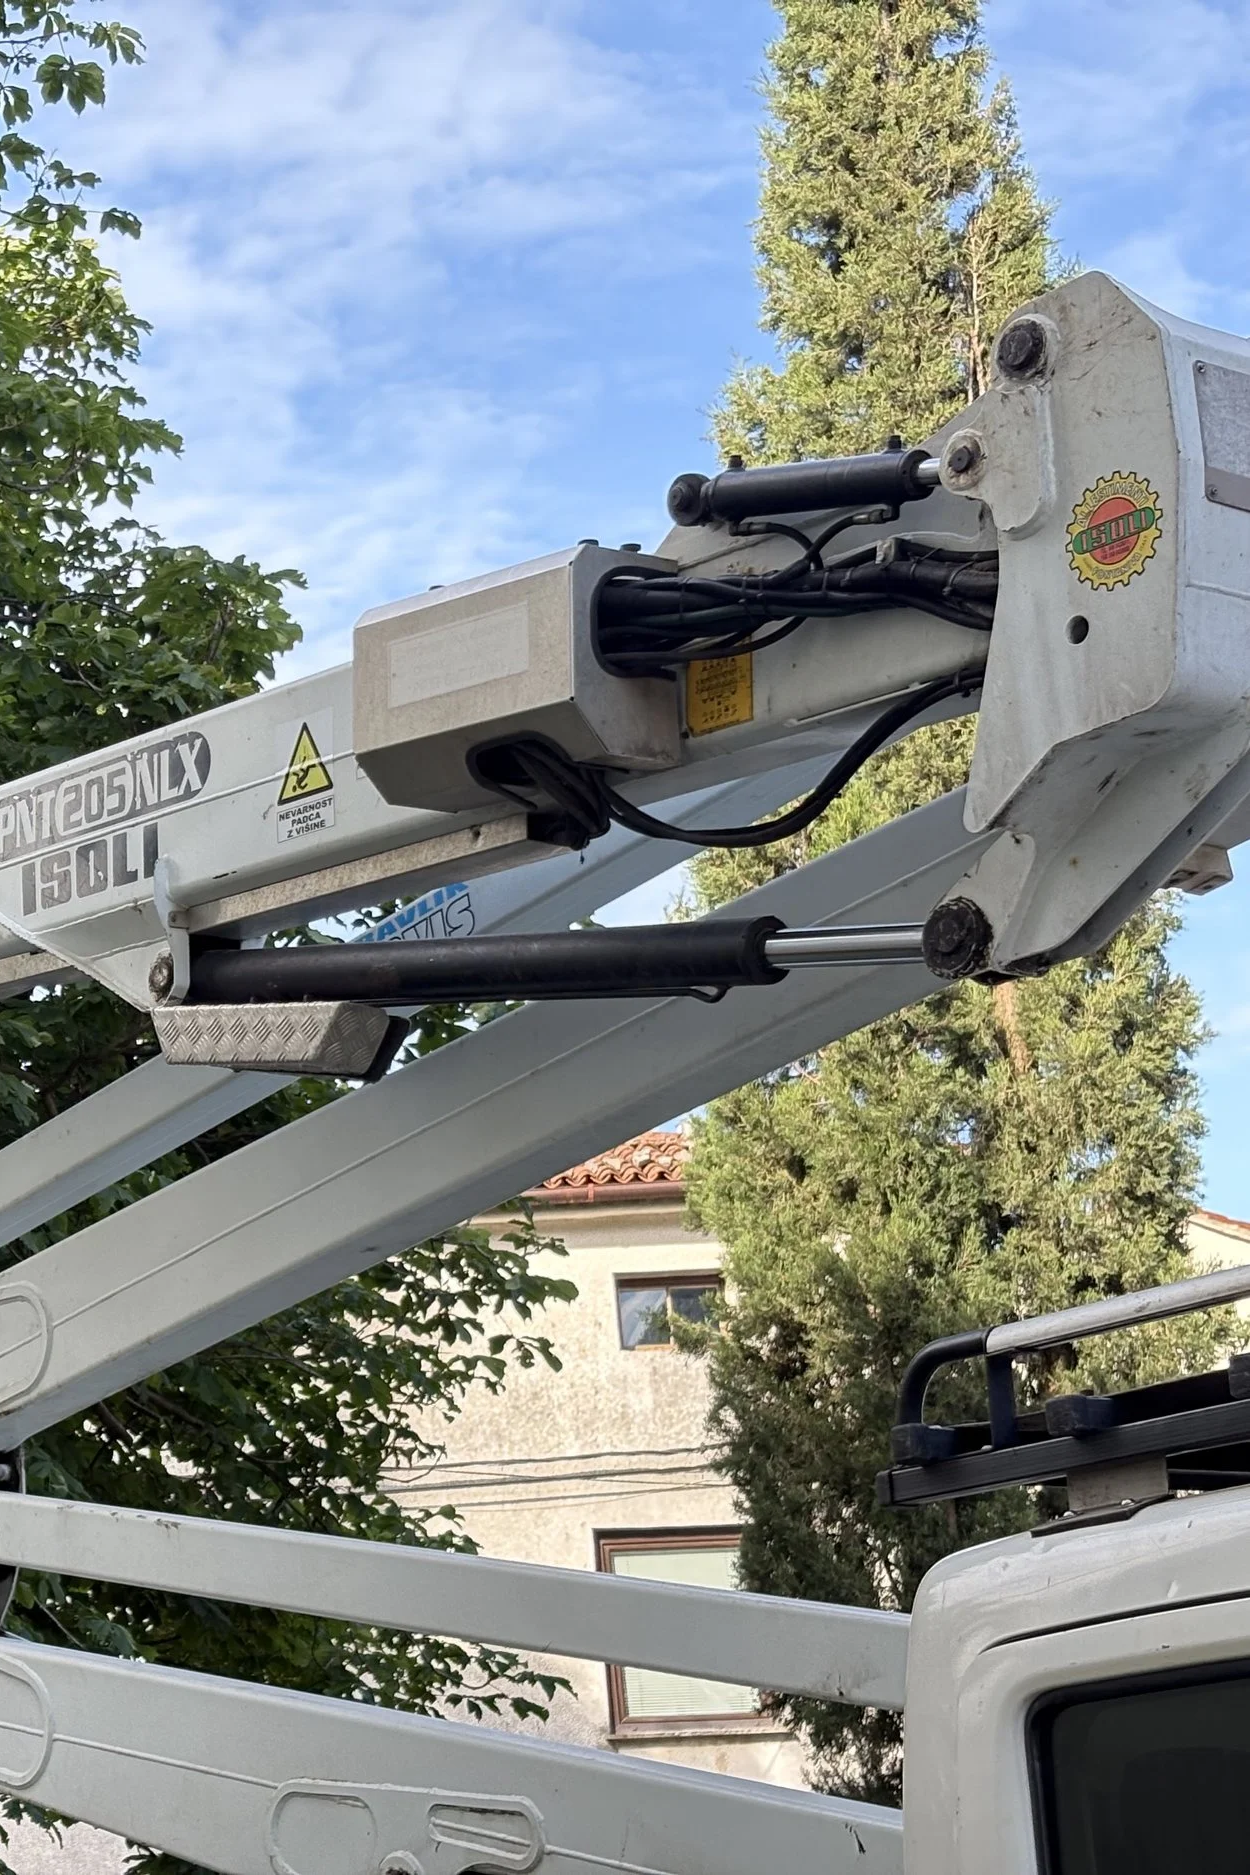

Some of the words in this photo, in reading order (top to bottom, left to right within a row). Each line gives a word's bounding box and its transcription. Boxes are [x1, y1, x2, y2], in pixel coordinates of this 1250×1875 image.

[1081, 510, 1147, 552] ISOLI
[278, 797, 333, 822] NEVARNOST
[291, 811, 321, 828] PADCA
[286, 829, 294, 839] Z
[295, 819, 326, 835] VIŠINE
[21, 821, 160, 917] ISOLI
